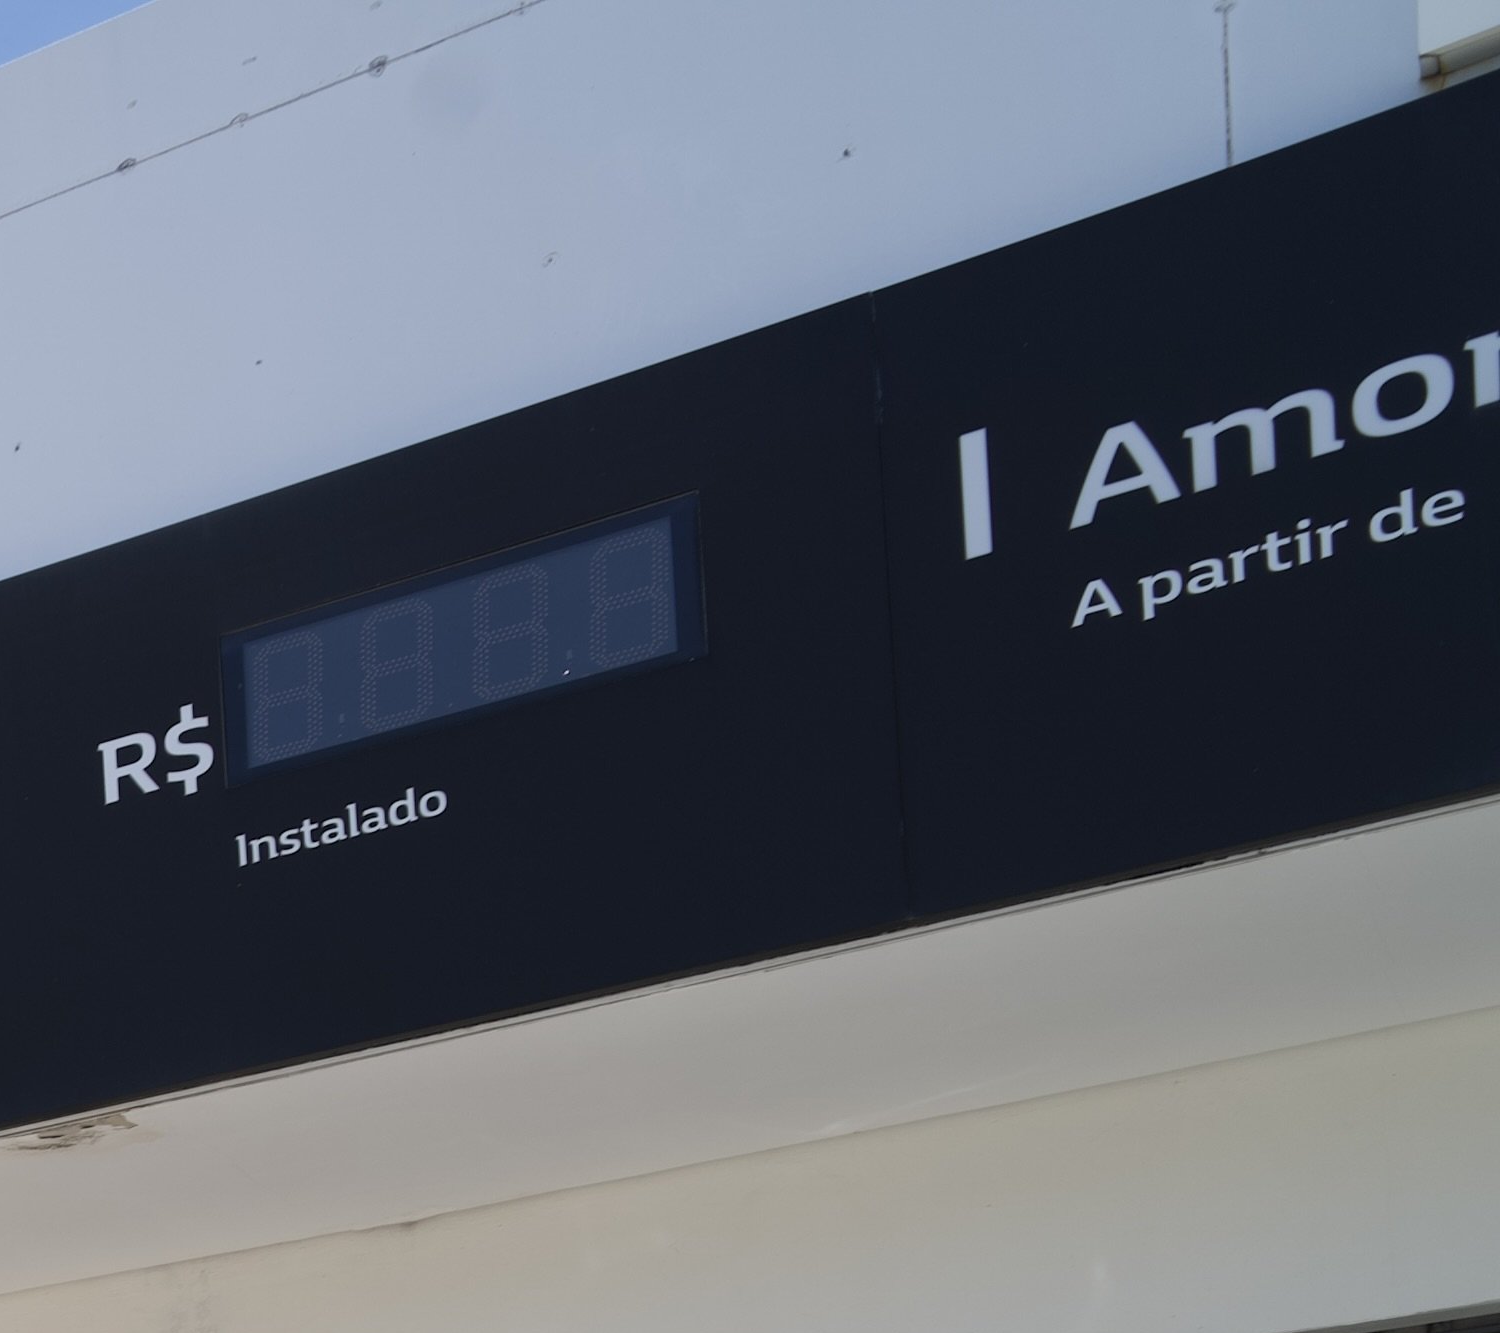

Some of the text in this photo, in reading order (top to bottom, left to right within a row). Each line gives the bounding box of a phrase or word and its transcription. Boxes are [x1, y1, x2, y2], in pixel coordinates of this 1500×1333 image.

[1071, 488, 1466, 628] A partir de
[97, 703, 214, 805] R$
[234, 787, 449, 868] Instalado
